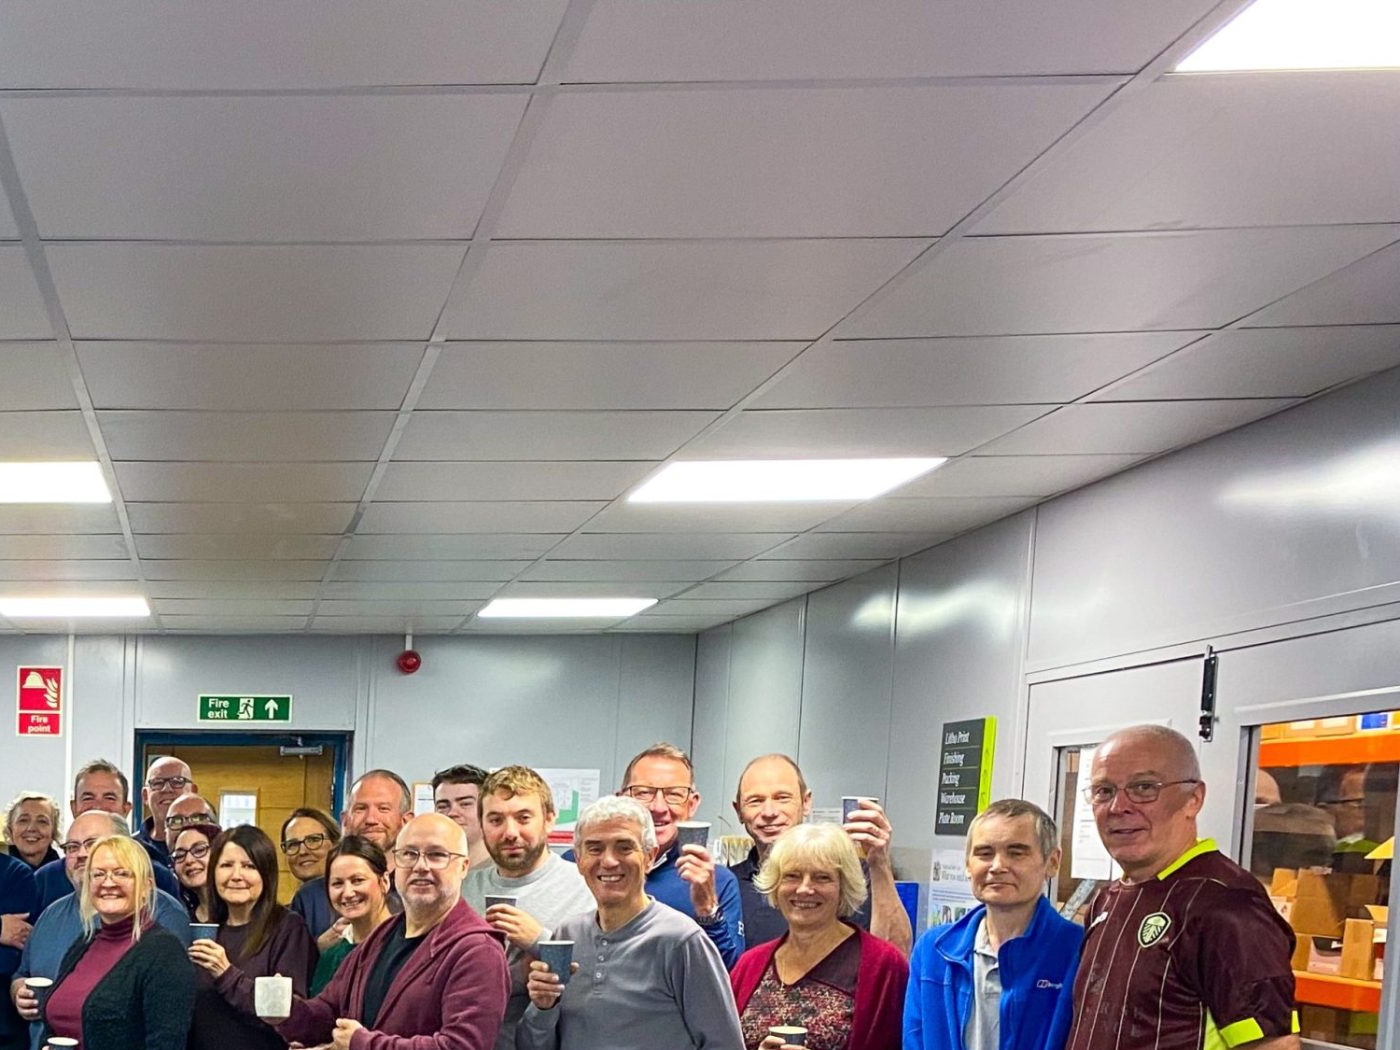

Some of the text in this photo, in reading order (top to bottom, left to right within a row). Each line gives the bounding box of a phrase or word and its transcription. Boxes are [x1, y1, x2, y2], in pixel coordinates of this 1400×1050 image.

[208, 697, 230, 709] Fire
[30, 714, 49, 723] Fire
[207, 709, 228, 719] exit
[27, 724, 51, 734] point
[957, 730, 970, 744] Print
[943, 751, 965, 767] Finishing
[941, 771, 961, 787] Packing
[940, 791, 966, 804] Warehouse
[950, 811, 965, 824] Room
